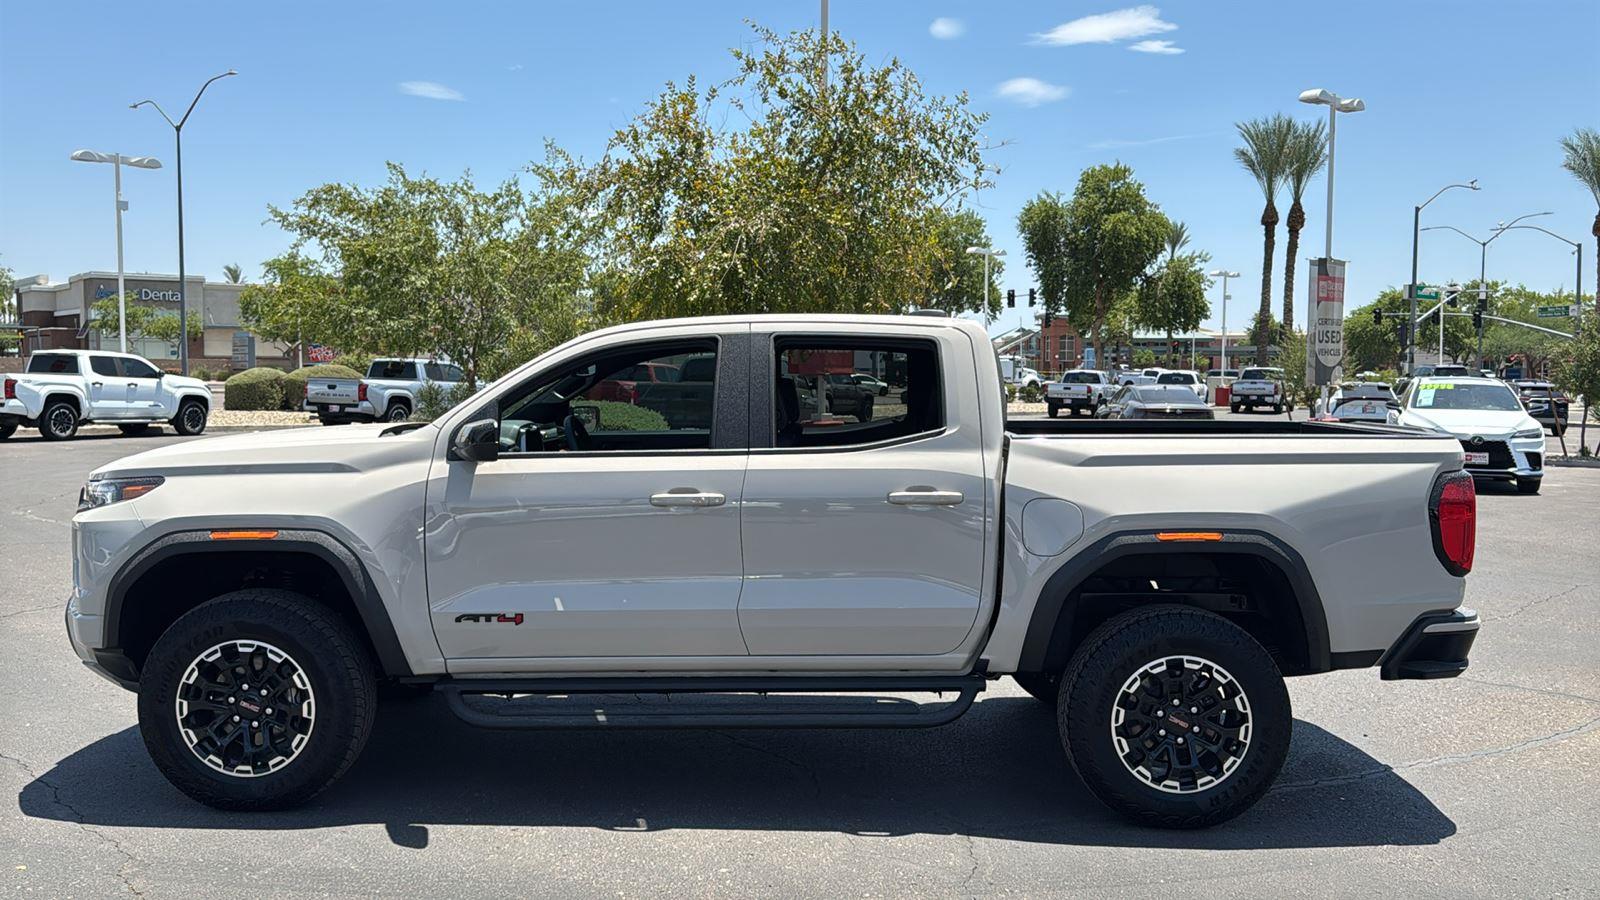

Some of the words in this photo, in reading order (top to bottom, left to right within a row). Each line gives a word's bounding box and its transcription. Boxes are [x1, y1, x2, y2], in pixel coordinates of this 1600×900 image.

[141, 288, 183, 302] Denta
[1317, 318, 1342, 327] CERTIFIED
[1317, 330, 1341, 344] USED
[1317, 348, 1341, 357] VEHICLES
[454, 612, 524, 626] AT4
[240, 700, 260, 713] GMC
[1168, 715, 1189, 729] GMC
